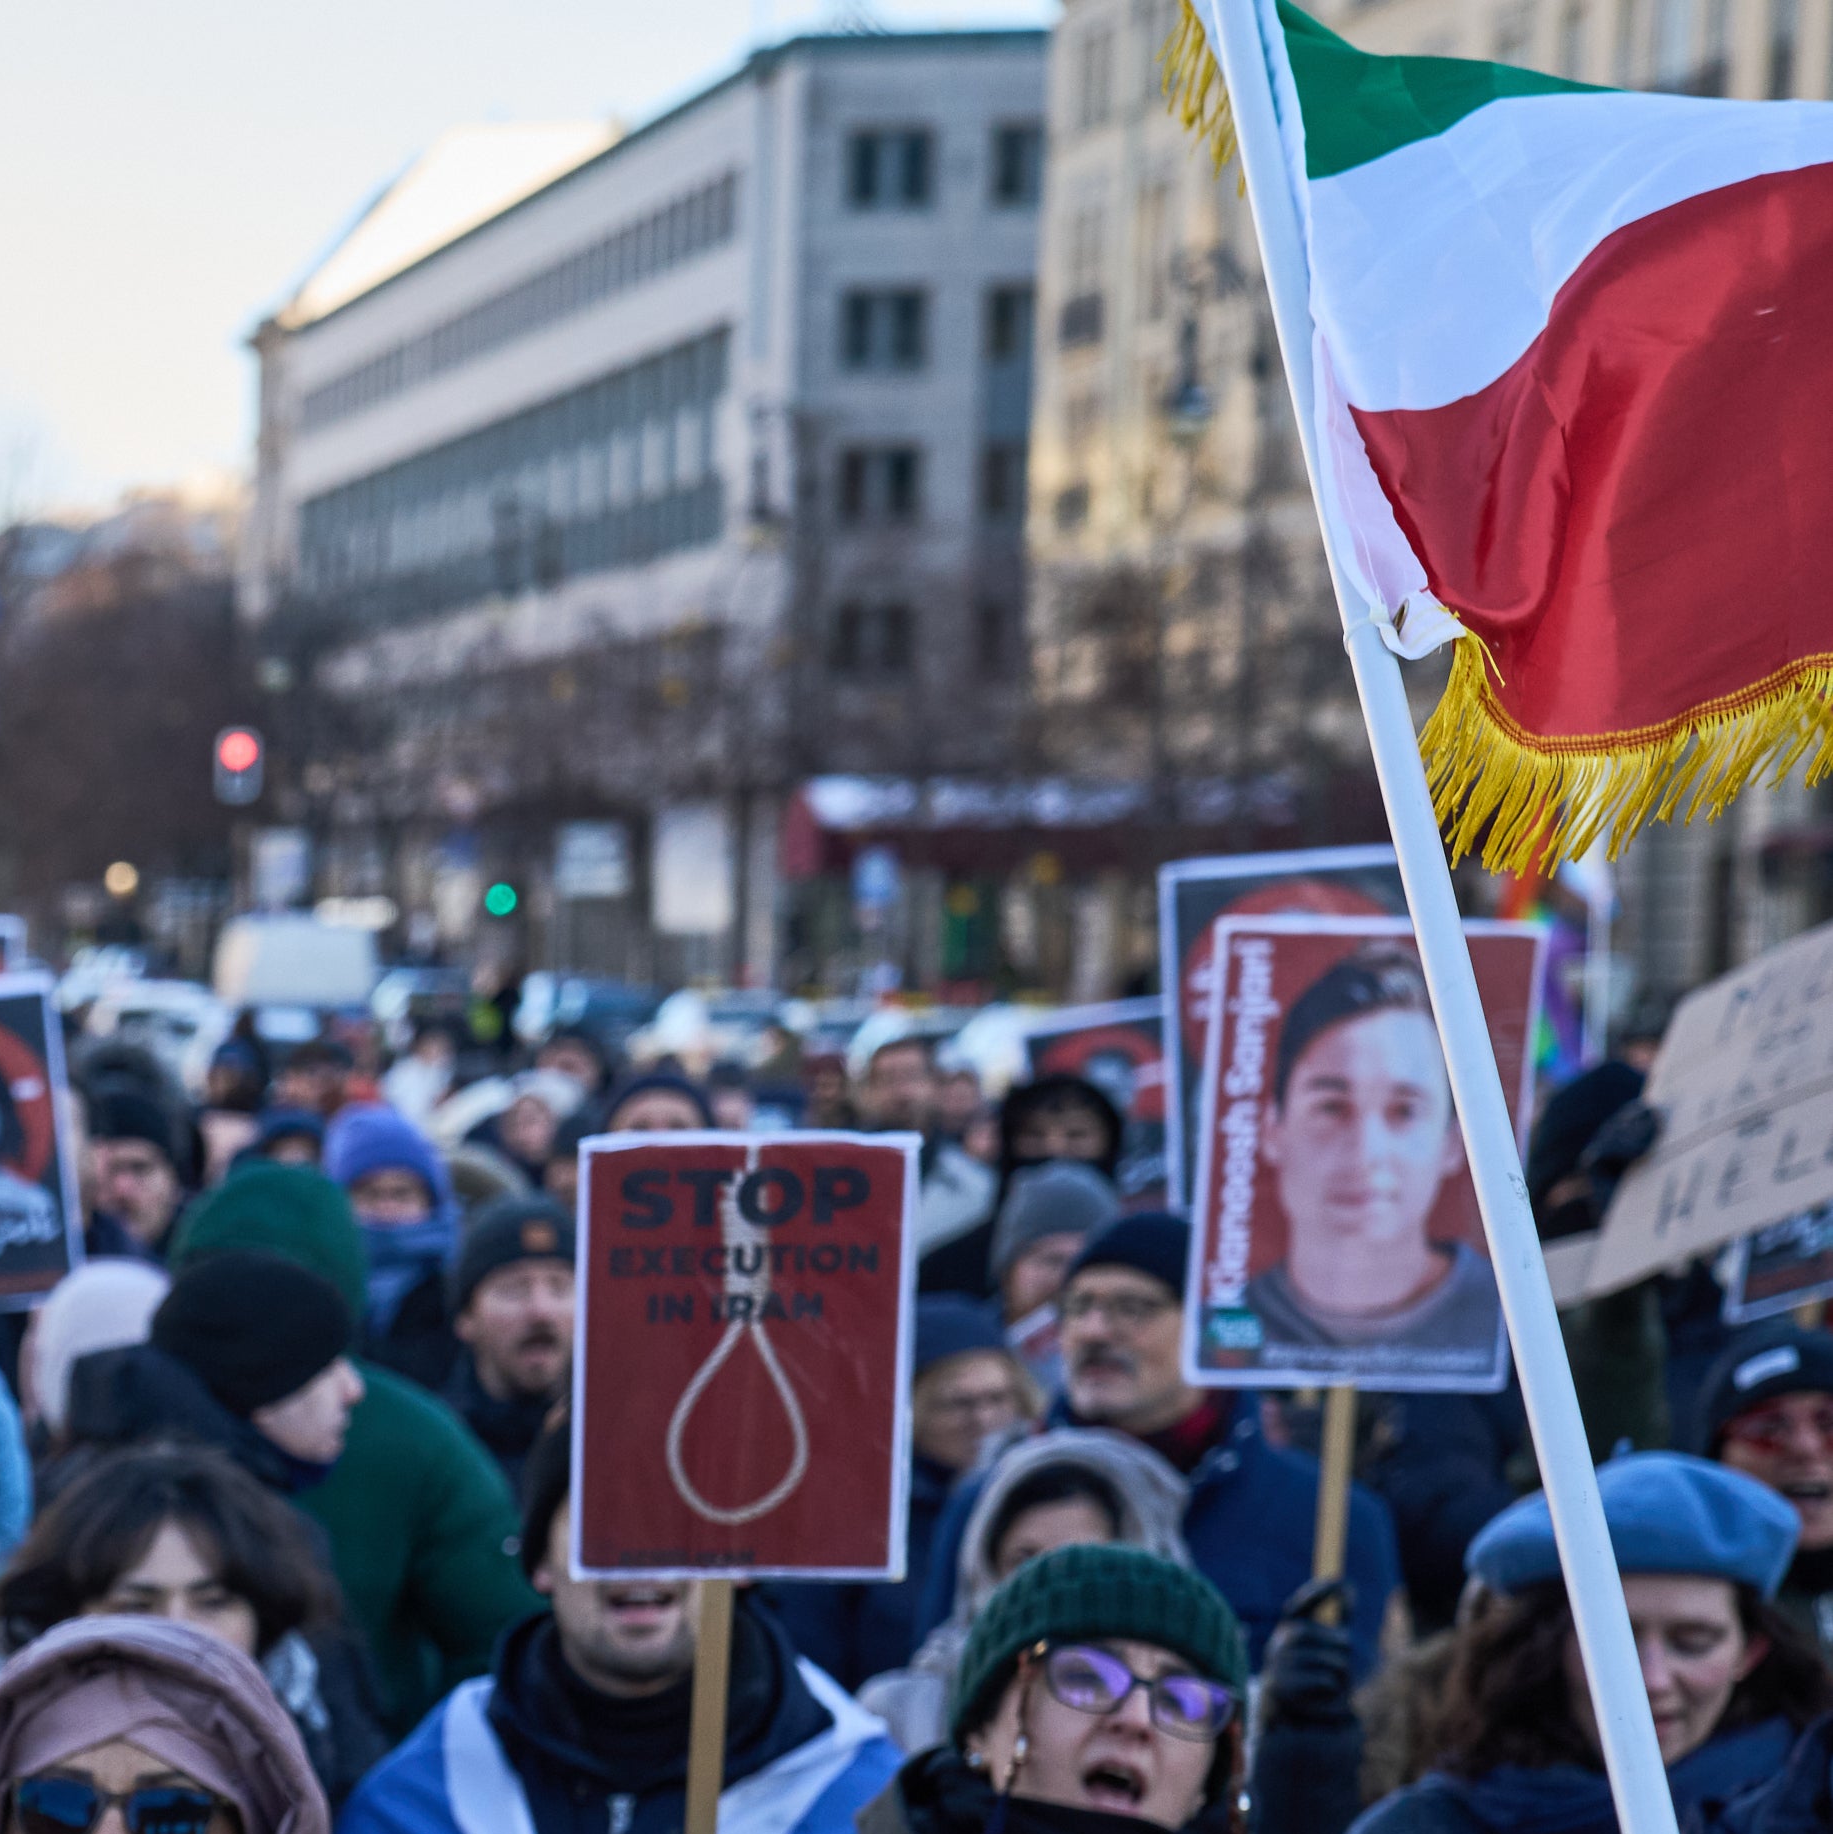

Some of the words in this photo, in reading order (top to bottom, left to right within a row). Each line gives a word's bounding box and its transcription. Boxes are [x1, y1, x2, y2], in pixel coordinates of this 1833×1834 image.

[620, 1165, 871, 1229] STOP
[609, 1243, 879, 1278] EXECUTION
[647, 1294, 693, 1324] IN
[710, 1292, 824, 1325] IRAN
